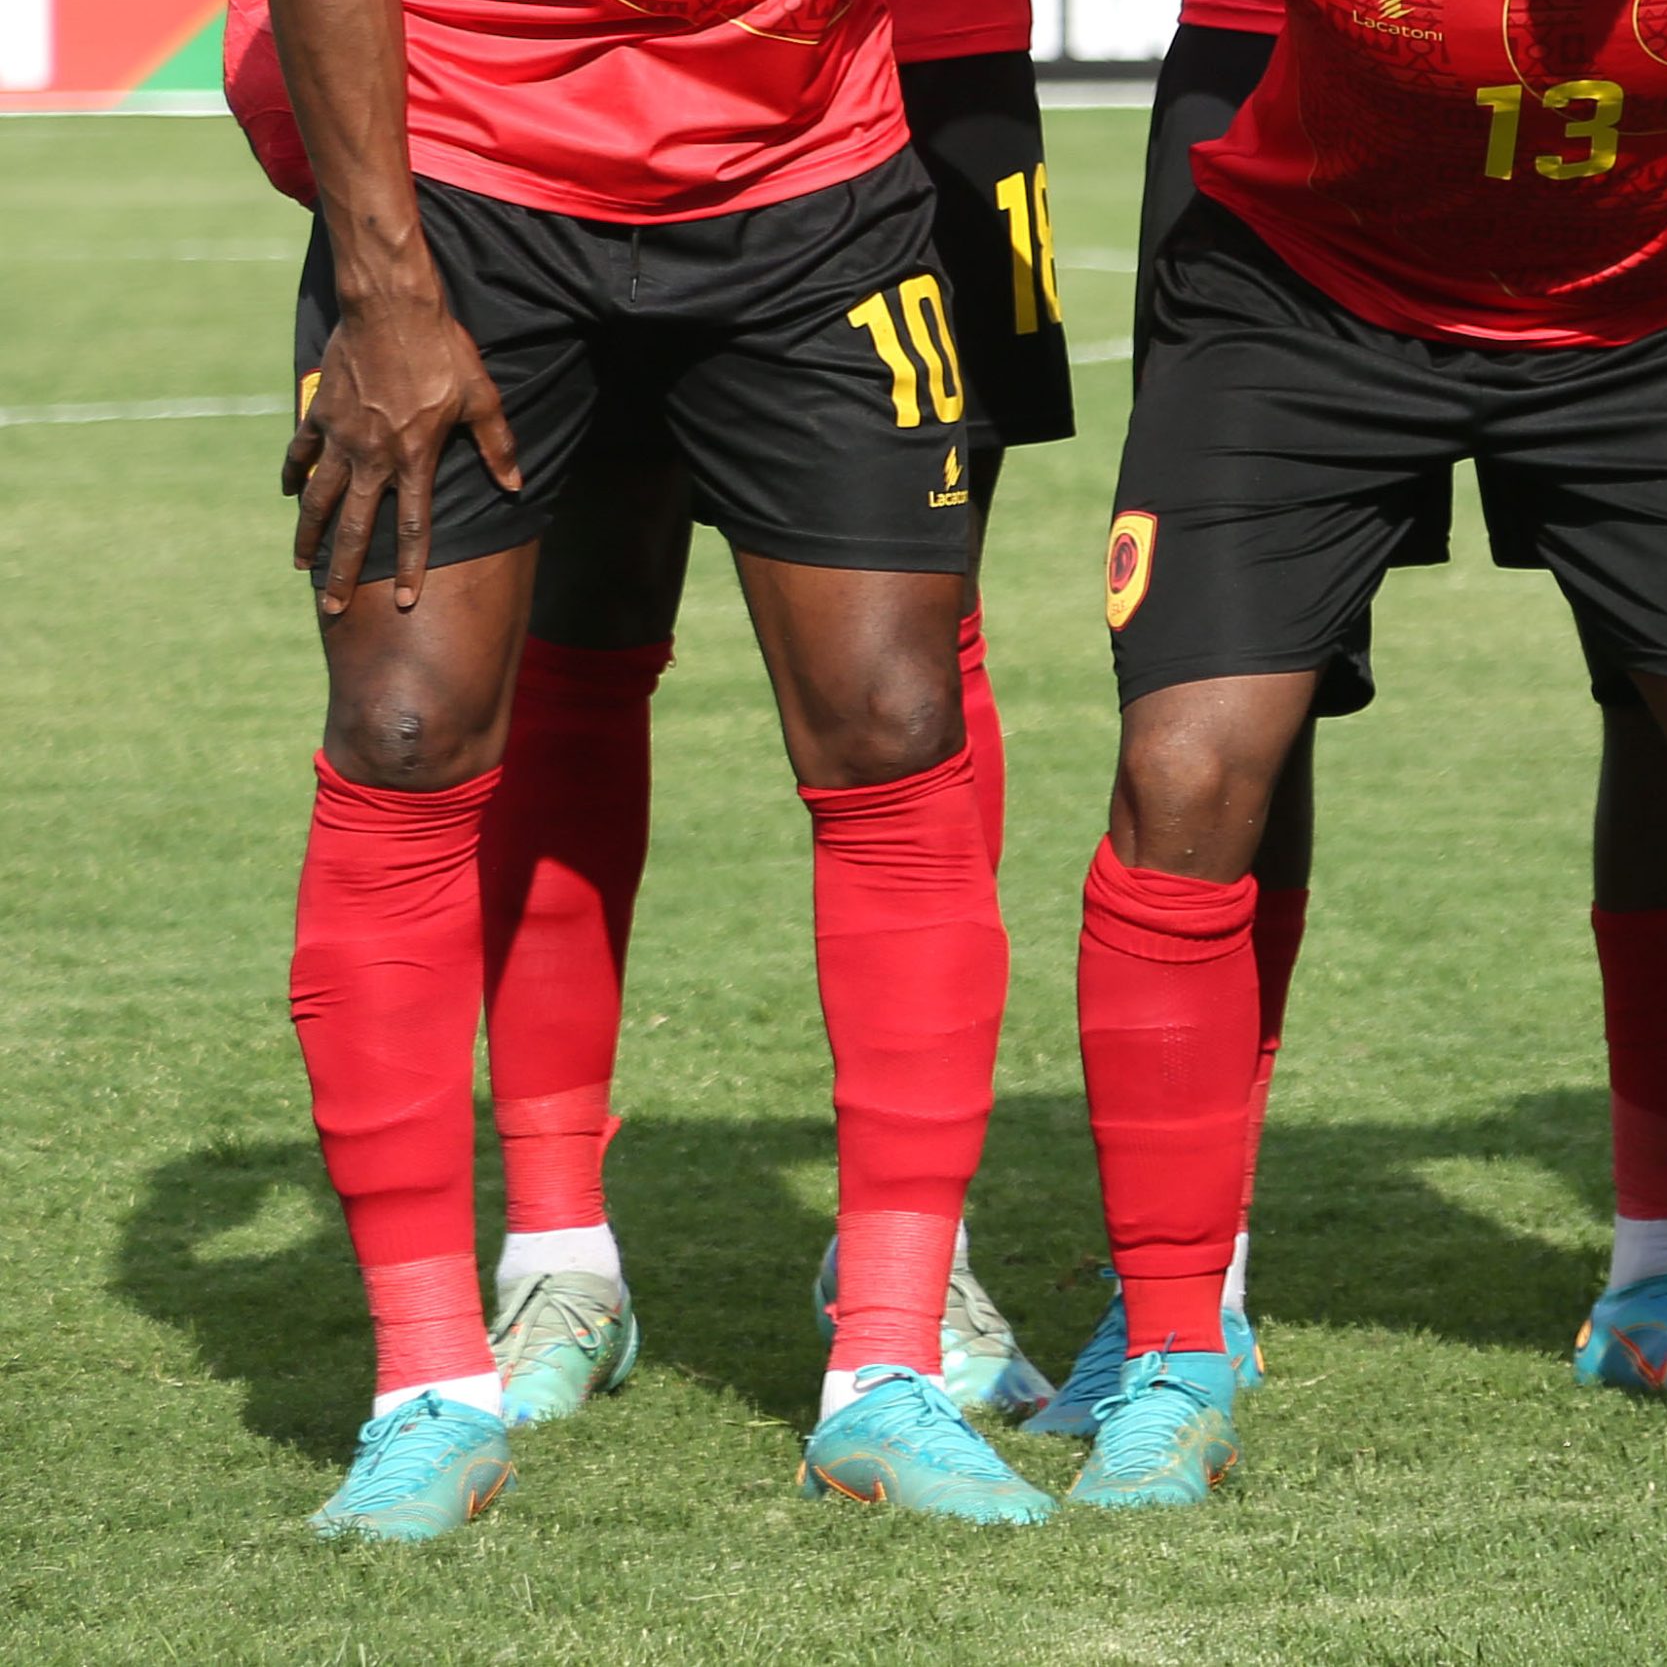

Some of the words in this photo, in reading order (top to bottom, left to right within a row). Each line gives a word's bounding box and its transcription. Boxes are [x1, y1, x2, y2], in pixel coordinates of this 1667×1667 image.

[1352, 8, 1443, 42] Lacatoni
[1476, 79, 1625, 181] 13
[847, 273, 965, 429] 10
